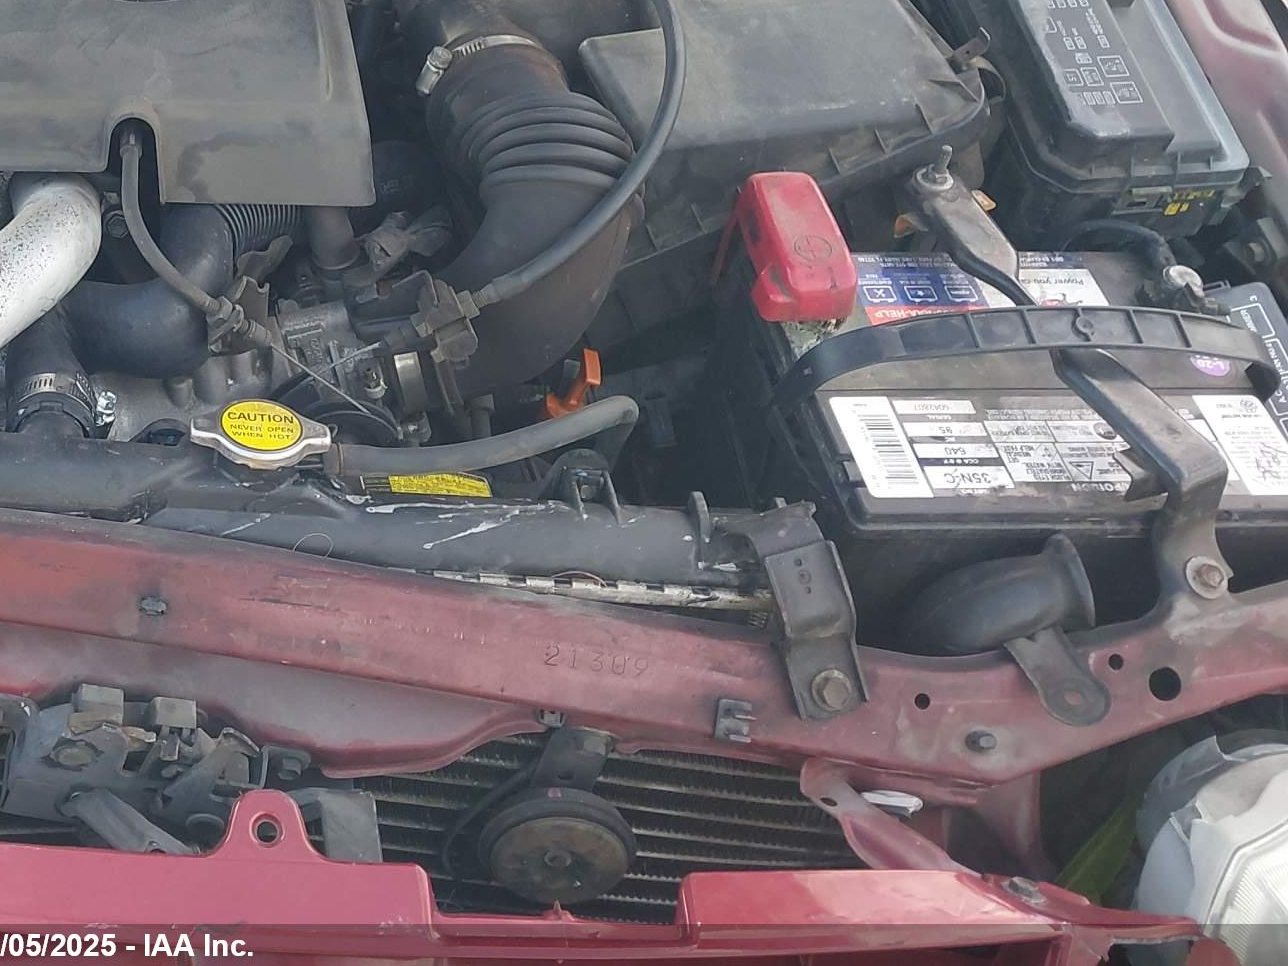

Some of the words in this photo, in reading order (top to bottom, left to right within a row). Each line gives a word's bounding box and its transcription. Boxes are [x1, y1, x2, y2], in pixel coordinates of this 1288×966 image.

[227, 411, 294, 424] CAUTION
[230, 424, 262, 432] NEVER
[232, 430, 263, 438] WHEN
[943, 472, 992, 484] 35N-C
